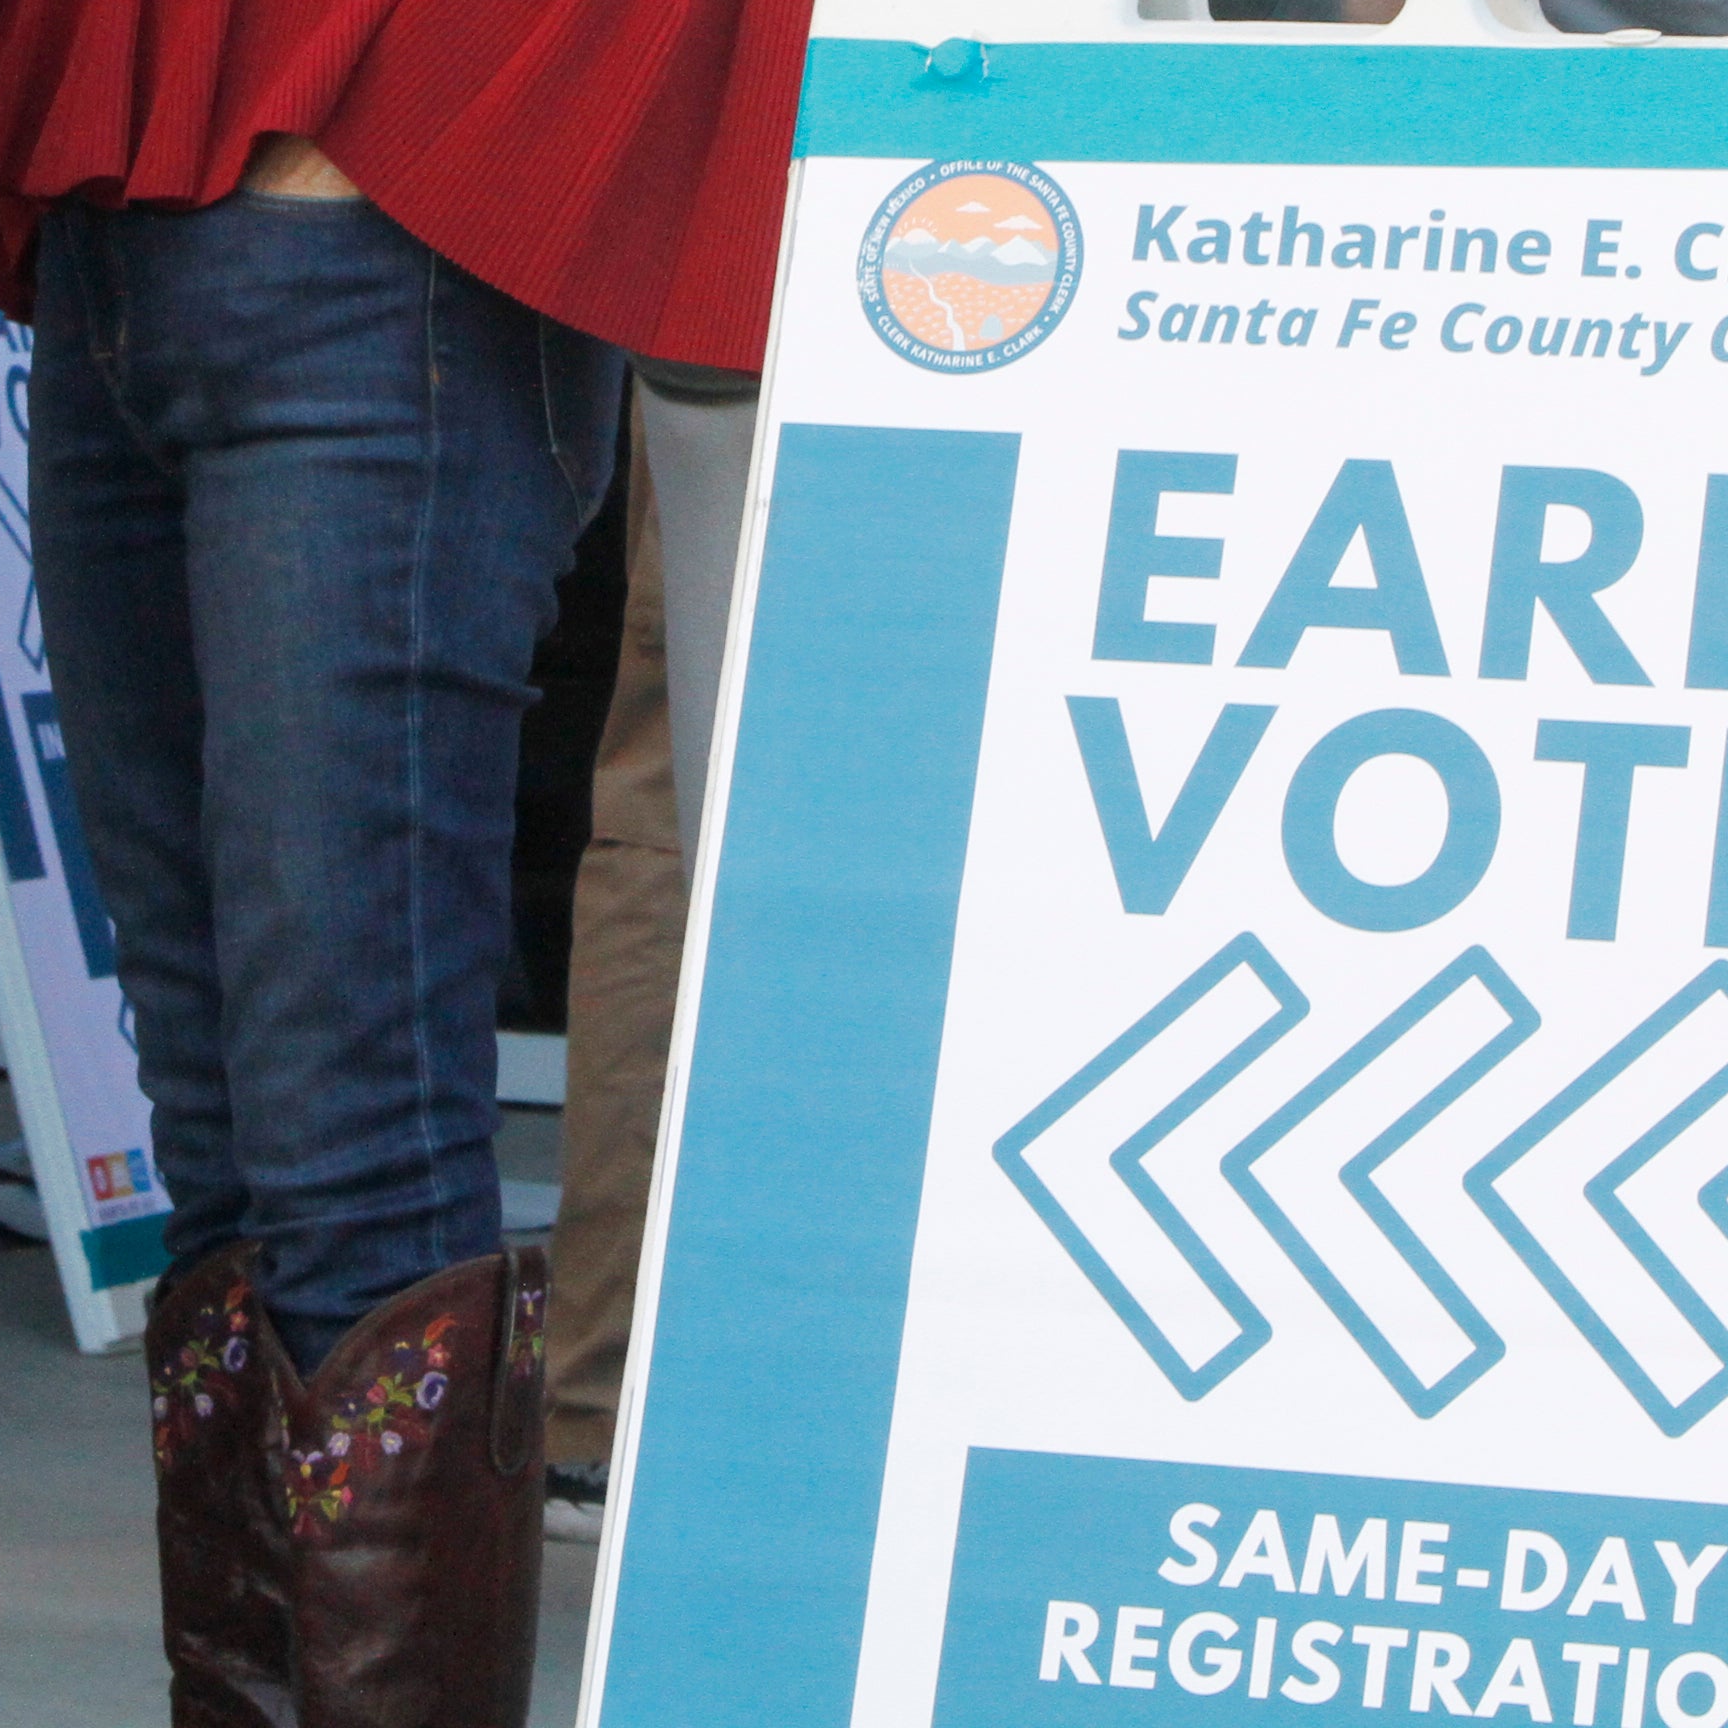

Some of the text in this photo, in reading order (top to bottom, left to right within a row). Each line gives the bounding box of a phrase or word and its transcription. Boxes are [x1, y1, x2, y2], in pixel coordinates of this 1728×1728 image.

[940, 160, 984, 177] OFFICE
[1005, 162, 1030, 182] THE
[887, 177, 926, 216] MEXICO
[1028, 174, 1062, 208] SANTA
[1055, 204, 1070, 221] FE
[1061, 221, 1079, 273] COUNTY
[1132, 203, 1552, 277] Katharine
[1580, 218, 1643, 279] E.
[1049, 272, 1075, 314] CLERK
[877, 314, 1044, 368] CLERK KATHARINE E. CLARK
[1117, 290, 1318, 347] Santa
[1335, 298, 1418, 351] Fe
[1439, 302, 1693, 377] County
